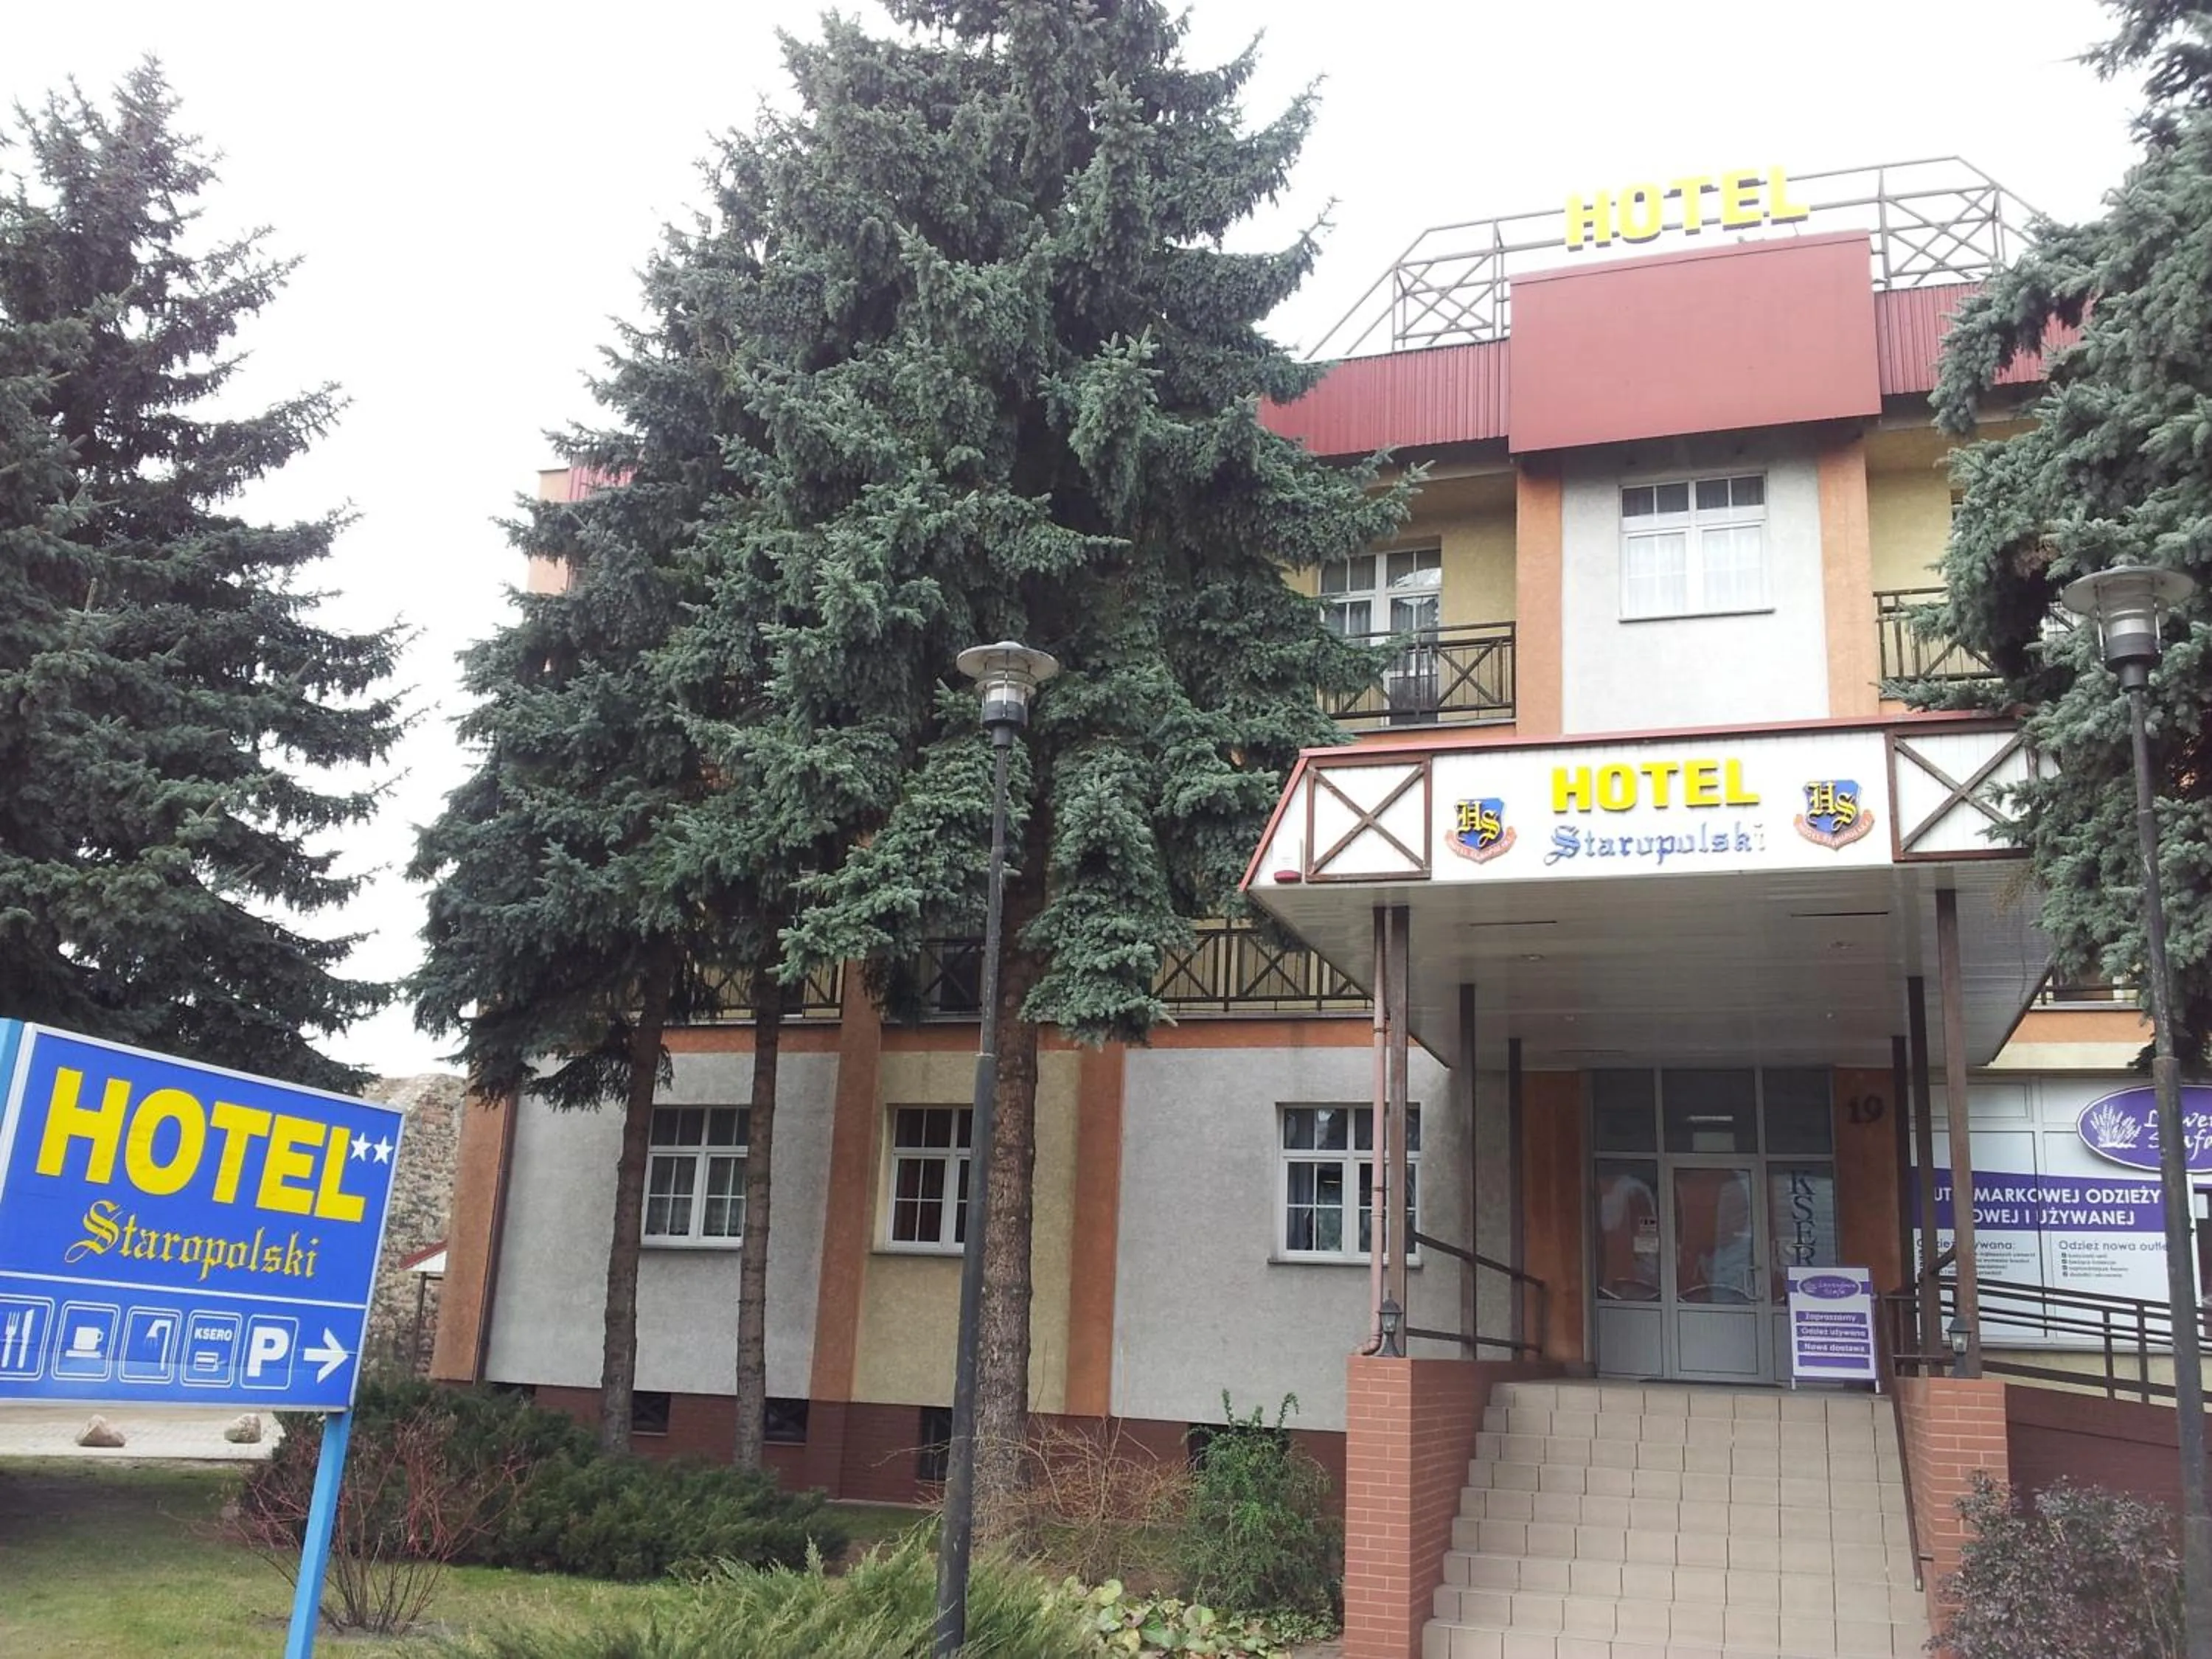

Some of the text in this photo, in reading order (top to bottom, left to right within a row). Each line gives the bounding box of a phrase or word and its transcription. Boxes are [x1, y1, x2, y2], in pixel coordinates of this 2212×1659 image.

[1564, 163, 1809, 252] HOTEL
[1551, 757, 1761, 813] HOTEL
[1543, 821, 1767, 865] Staropolski
[1847, 1094, 1885, 1124] 19
[35, 1065, 366, 1223] HOTEL
[1972, 1206, 2135, 1225] OWEJ I UŻYWANEJ
[1974, 1187, 2080, 1204] MARKOWEJ
[2085, 1185, 2162, 1204] ODZIEŻY
[64, 1199, 320, 1281] Staropolski
[2103, 1242, 2136, 1251] nowa
[194, 1327, 234, 1342] KSERO
[247, 1326, 290, 1377] P
